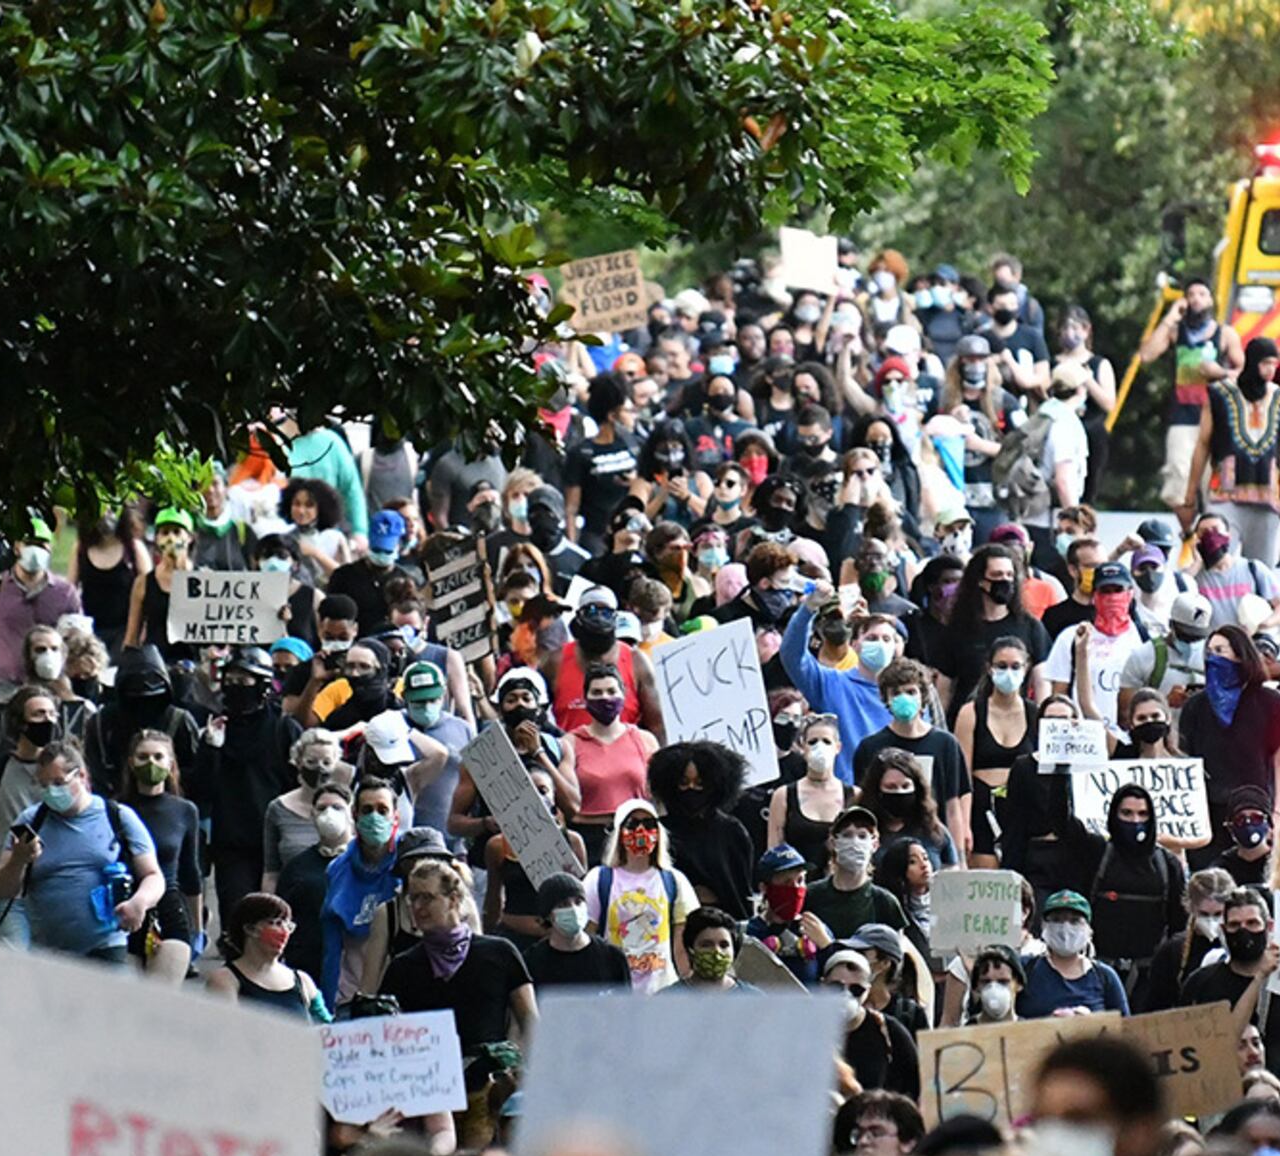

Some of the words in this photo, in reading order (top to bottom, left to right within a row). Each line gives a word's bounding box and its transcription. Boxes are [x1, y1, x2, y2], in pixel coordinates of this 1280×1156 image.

[565, 252, 633, 281] JUSTICE
[581, 290, 639, 317] FLOYD
[186, 576, 261, 600] BLACK
[204, 603, 255, 621] LIVES
[183, 622, 260, 643] MATTER
[656, 641, 758, 726] FUCK
[470, 730, 504, 780] STOP
[1126, 763, 1198, 793] JUSTICE
[1152, 793, 1195, 818] EACE
[967, 879, 1020, 901] JUSTICE
[963, 912, 1010, 936] PEACE
[320, 1026, 374, 1049] Brian
[382, 1021, 430, 1044] Kemp
[322, 1069, 357, 1090] Cops
